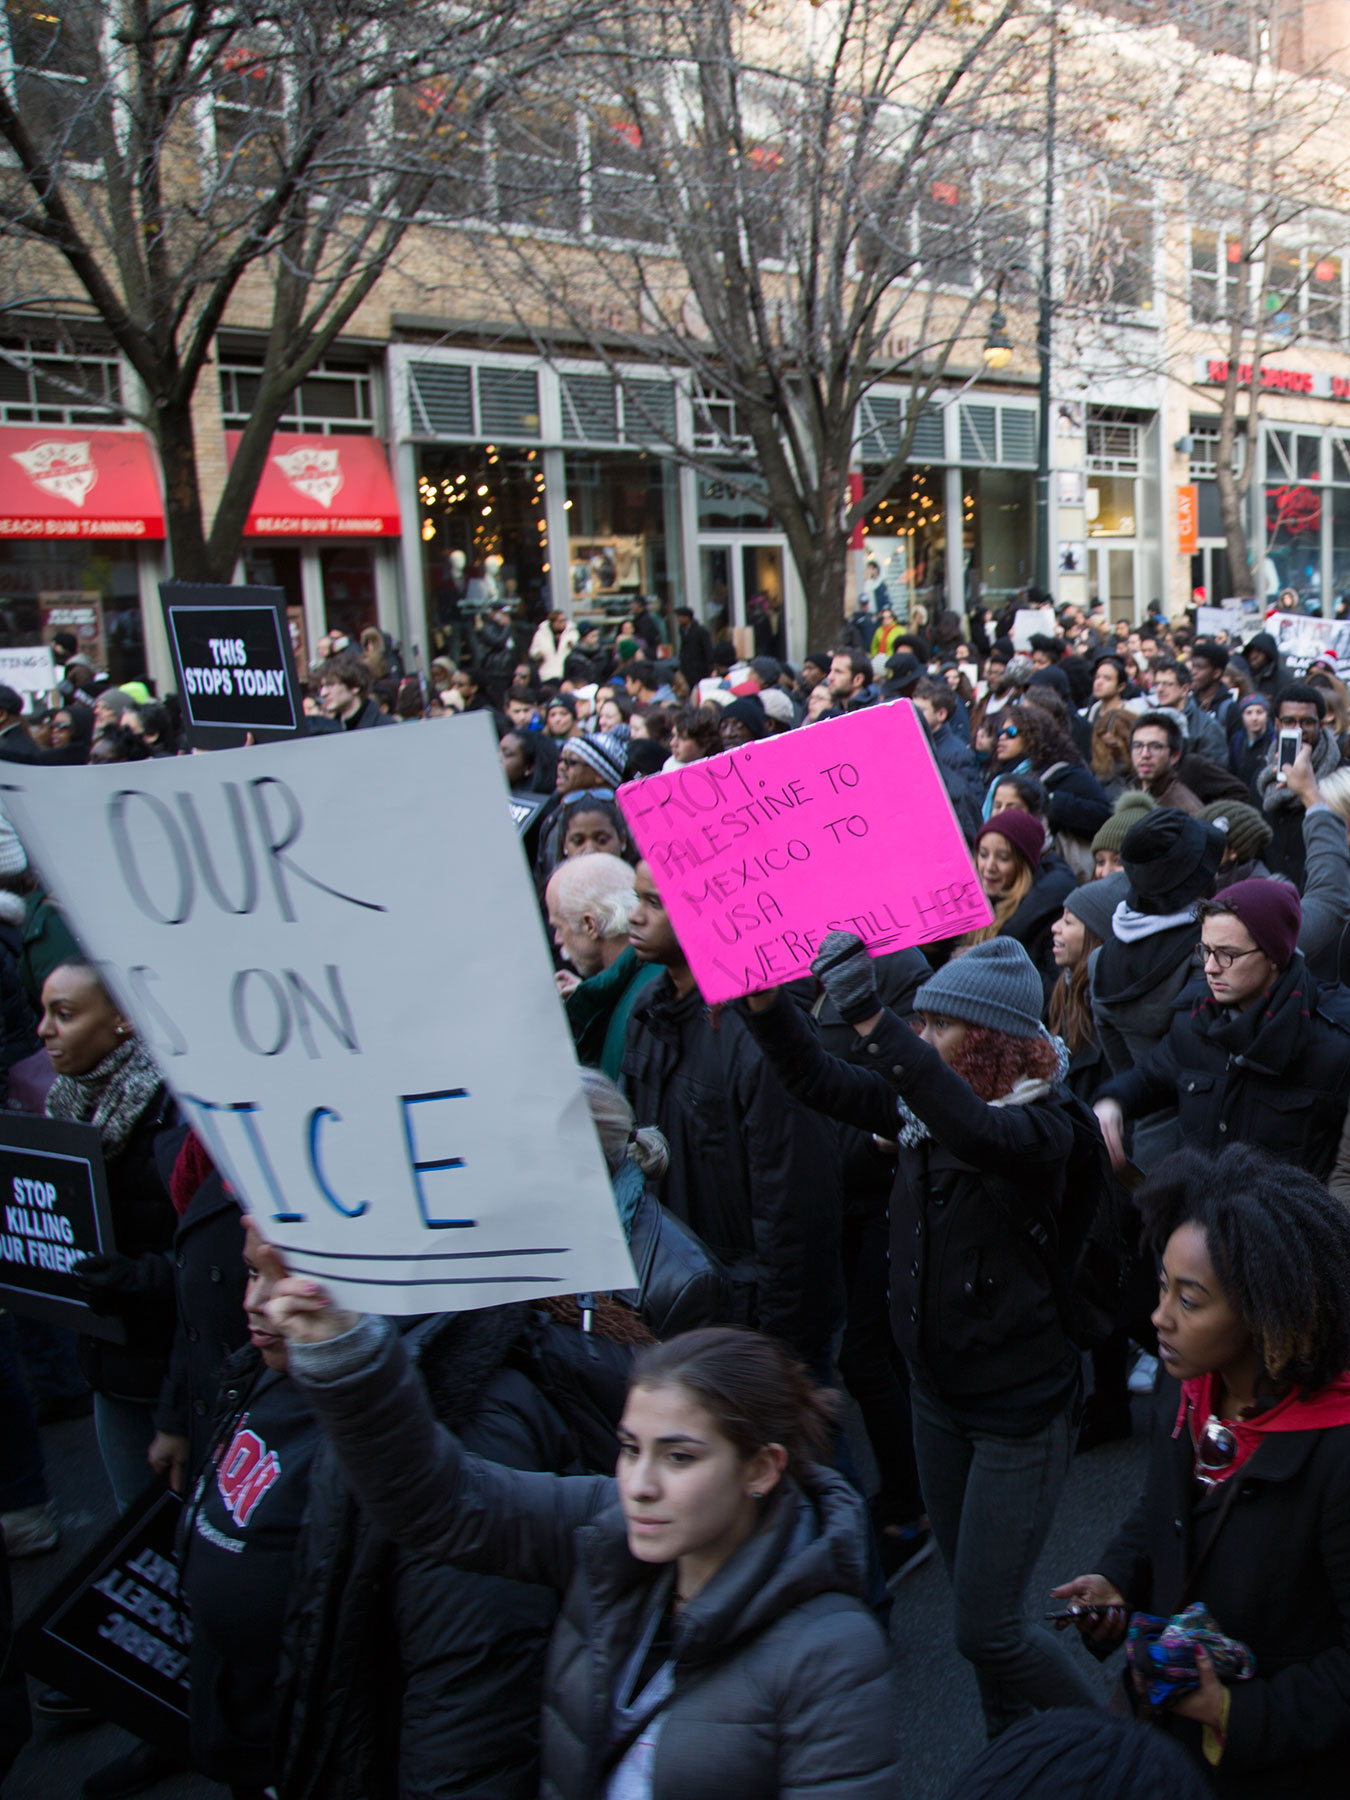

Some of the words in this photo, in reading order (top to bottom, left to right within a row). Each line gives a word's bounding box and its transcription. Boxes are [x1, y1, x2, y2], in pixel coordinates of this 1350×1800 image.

[1177, 495, 1192, 536] CLAY
[208, 637, 248, 666] THIS
[185, 667, 233, 695] STOPS
[233, 668, 285, 696] TODAY
[622, 754, 765, 834] FROM:
[648, 779, 814, 880] PALESTINE
[819, 762, 860, 795] TO
[108, 775, 389, 925] OUR
[680, 838, 811, 917] MEXICO
[822, 814, 869, 844] TO
[711, 890, 783, 945] USA
[911, 880, 986, 929] HERE
[231, 962, 363, 1059] ON
[13, 1176, 57, 1211] STOP
[5, 1205, 75, 1245] KILLING
[27, 1239, 96, 1277] FRIEN
